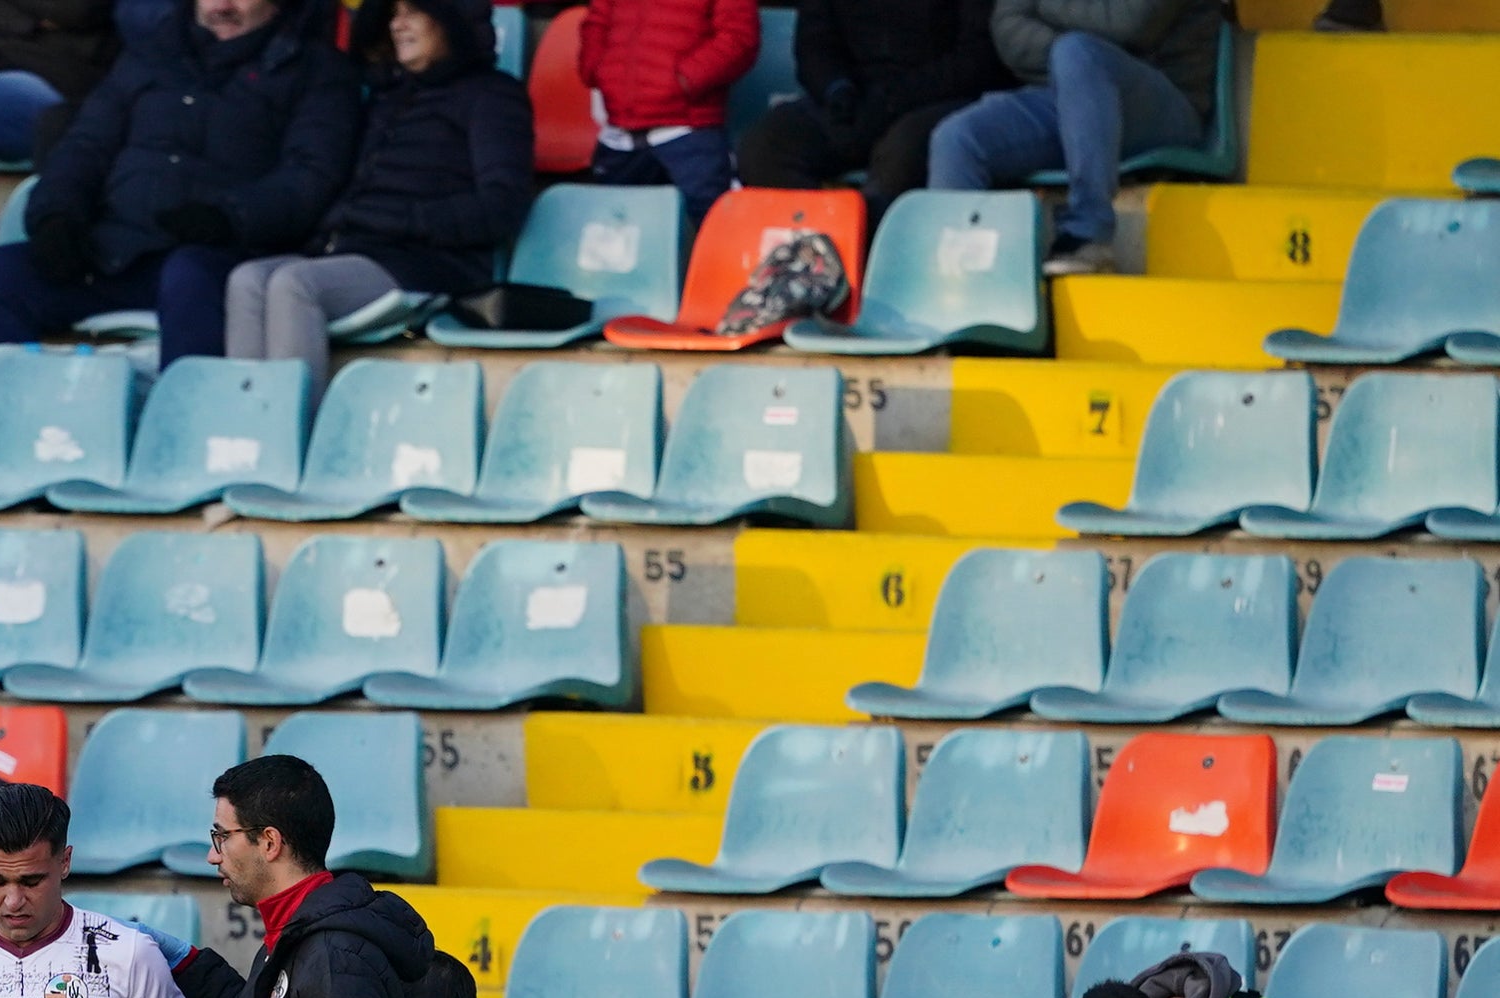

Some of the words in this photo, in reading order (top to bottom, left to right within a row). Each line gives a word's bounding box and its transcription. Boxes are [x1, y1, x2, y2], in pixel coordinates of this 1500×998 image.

[1288, 229, 1311, 266] 8
[843, 377, 887, 412] 55
[1088, 398, 1111, 435] 7
[644, 550, 687, 582] 55
[881, 571, 905, 609] 6
[696, 915, 728, 953] 5
[469, 935, 492, 972] 4
